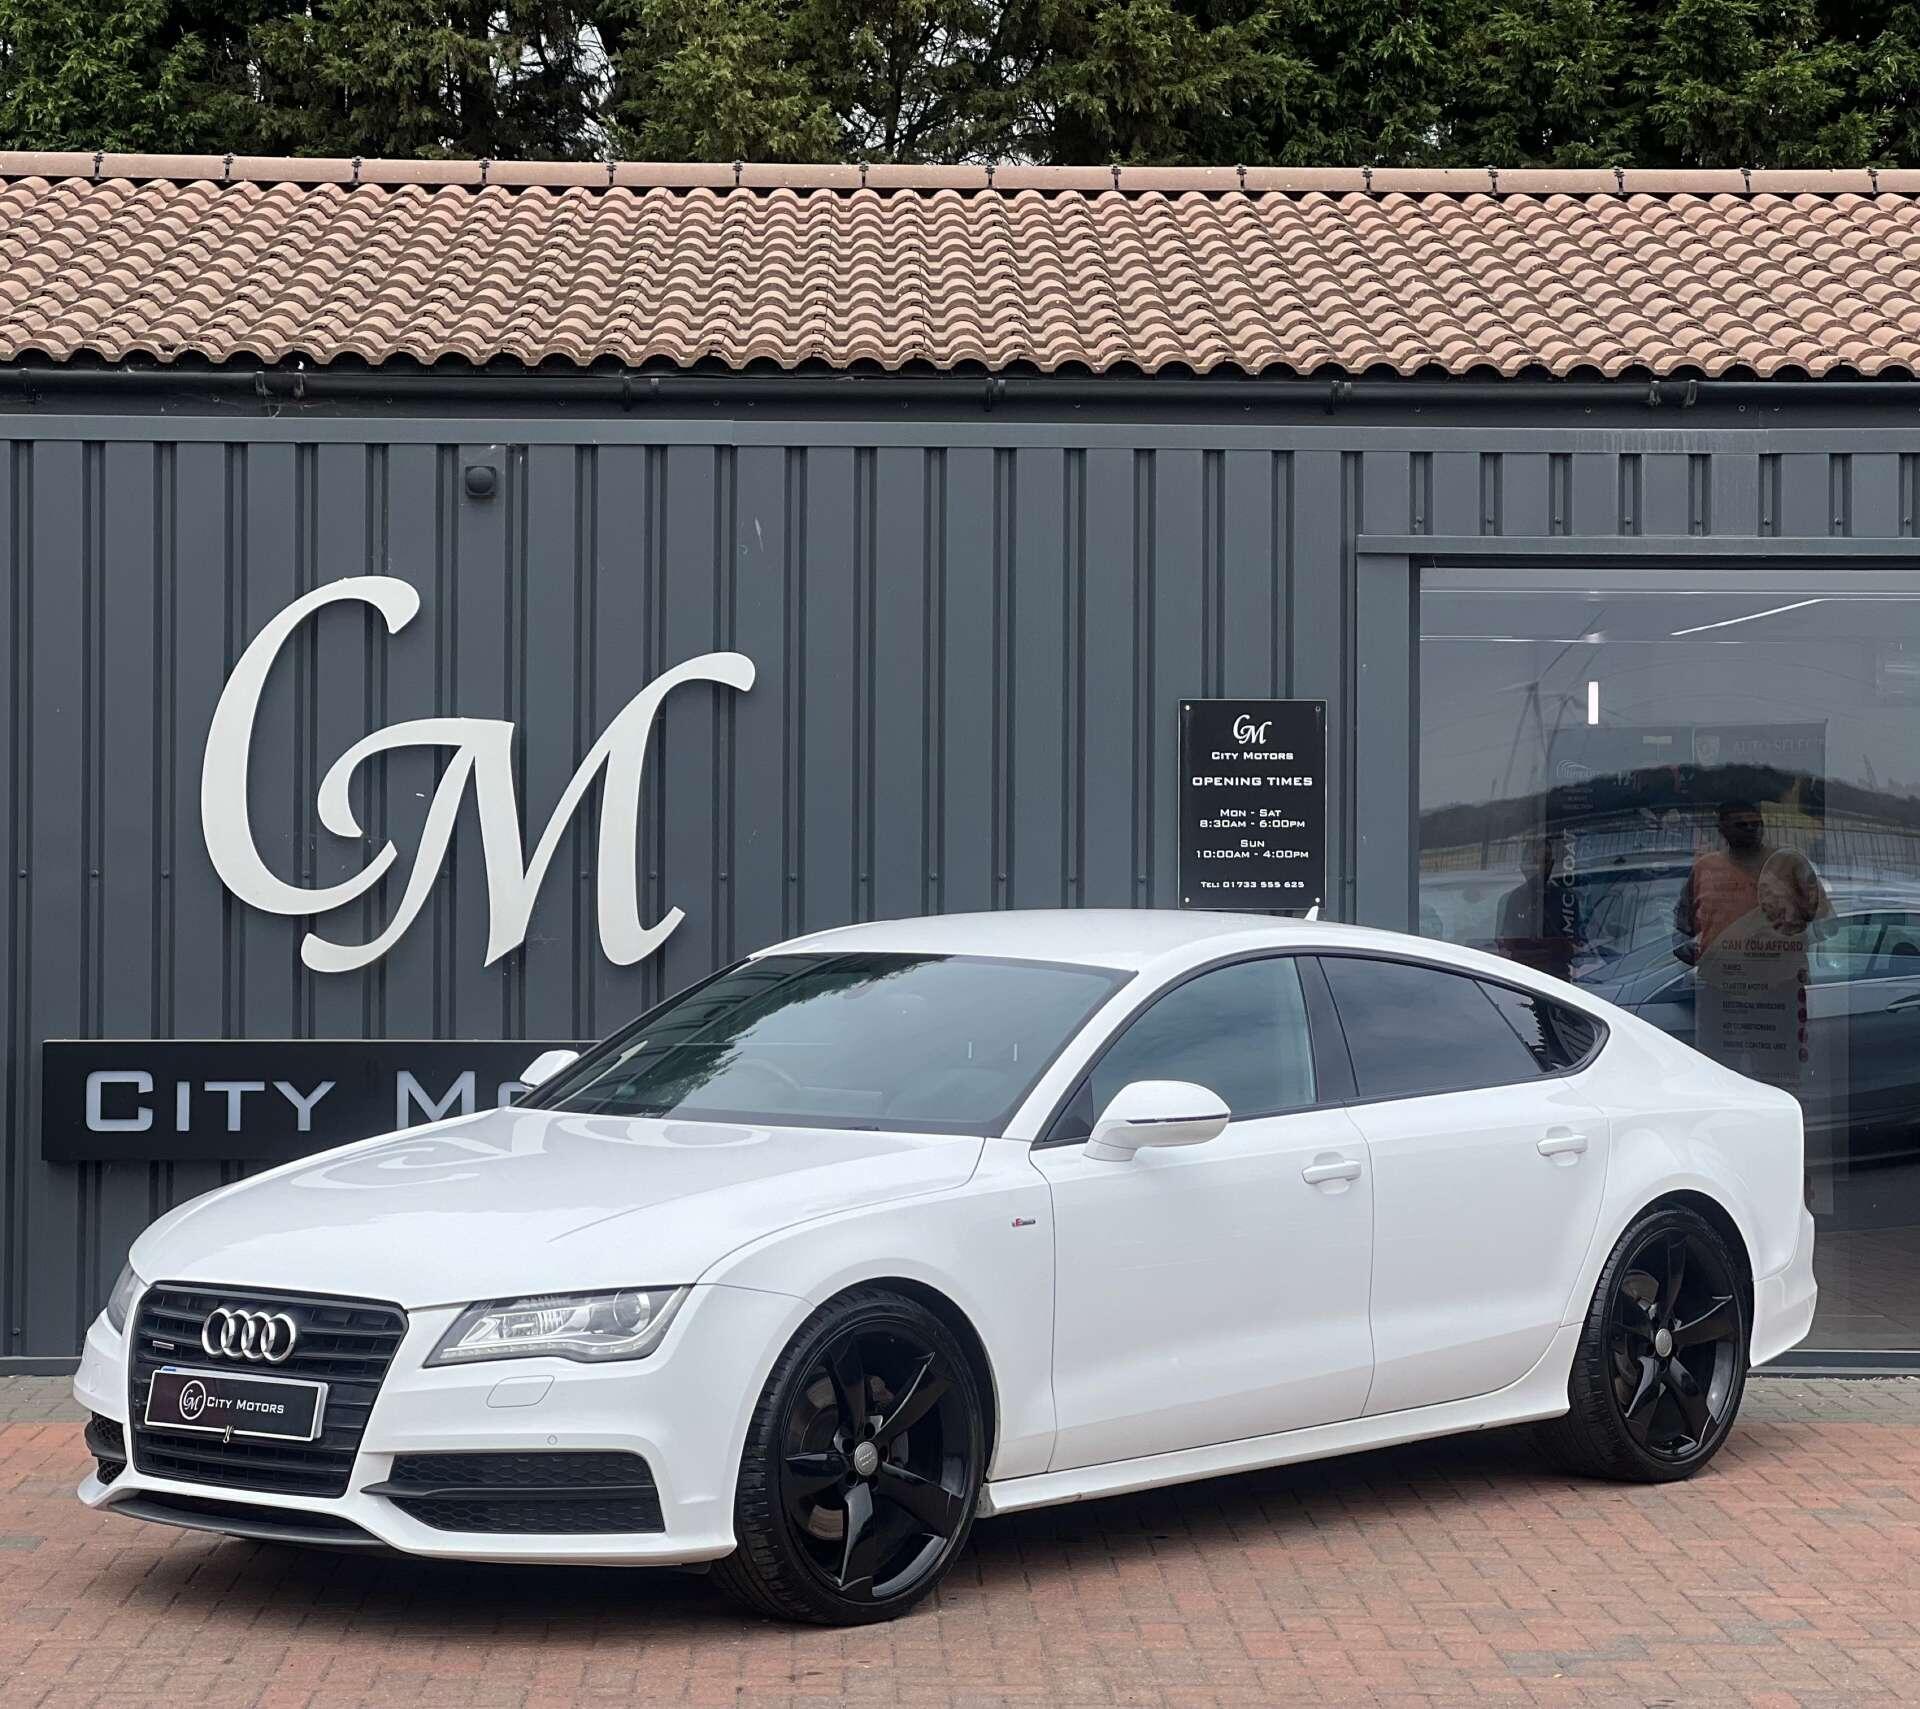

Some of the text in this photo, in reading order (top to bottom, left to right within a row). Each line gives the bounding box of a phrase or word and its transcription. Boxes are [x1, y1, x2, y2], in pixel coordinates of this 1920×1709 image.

[1211, 751, 1294, 761] CITY MOTORS
[1192, 776, 1313, 787] OPENING TIMES
[1219, 808, 1247, 818] MON
[1259, 808, 1282, 818] SAT
[1199, 819, 1247, 829] 8:30AM
[1259, 819, 1306, 828] 6:00PM
[1240, 839, 1265, 848] SUN
[1196, 850, 1250, 859] 10:00AM
[1262, 850, 1309, 859] 4:00PM
[1200, 881, 1305, 889] TEL: 01733 555 625
[1721, 939, 1804, 952] CAN YOU AFFORD
[85, 1070, 335, 1132] CITY
[206, 1396, 233, 1409] CITY
[236, 1399, 285, 1414] MOTORS
